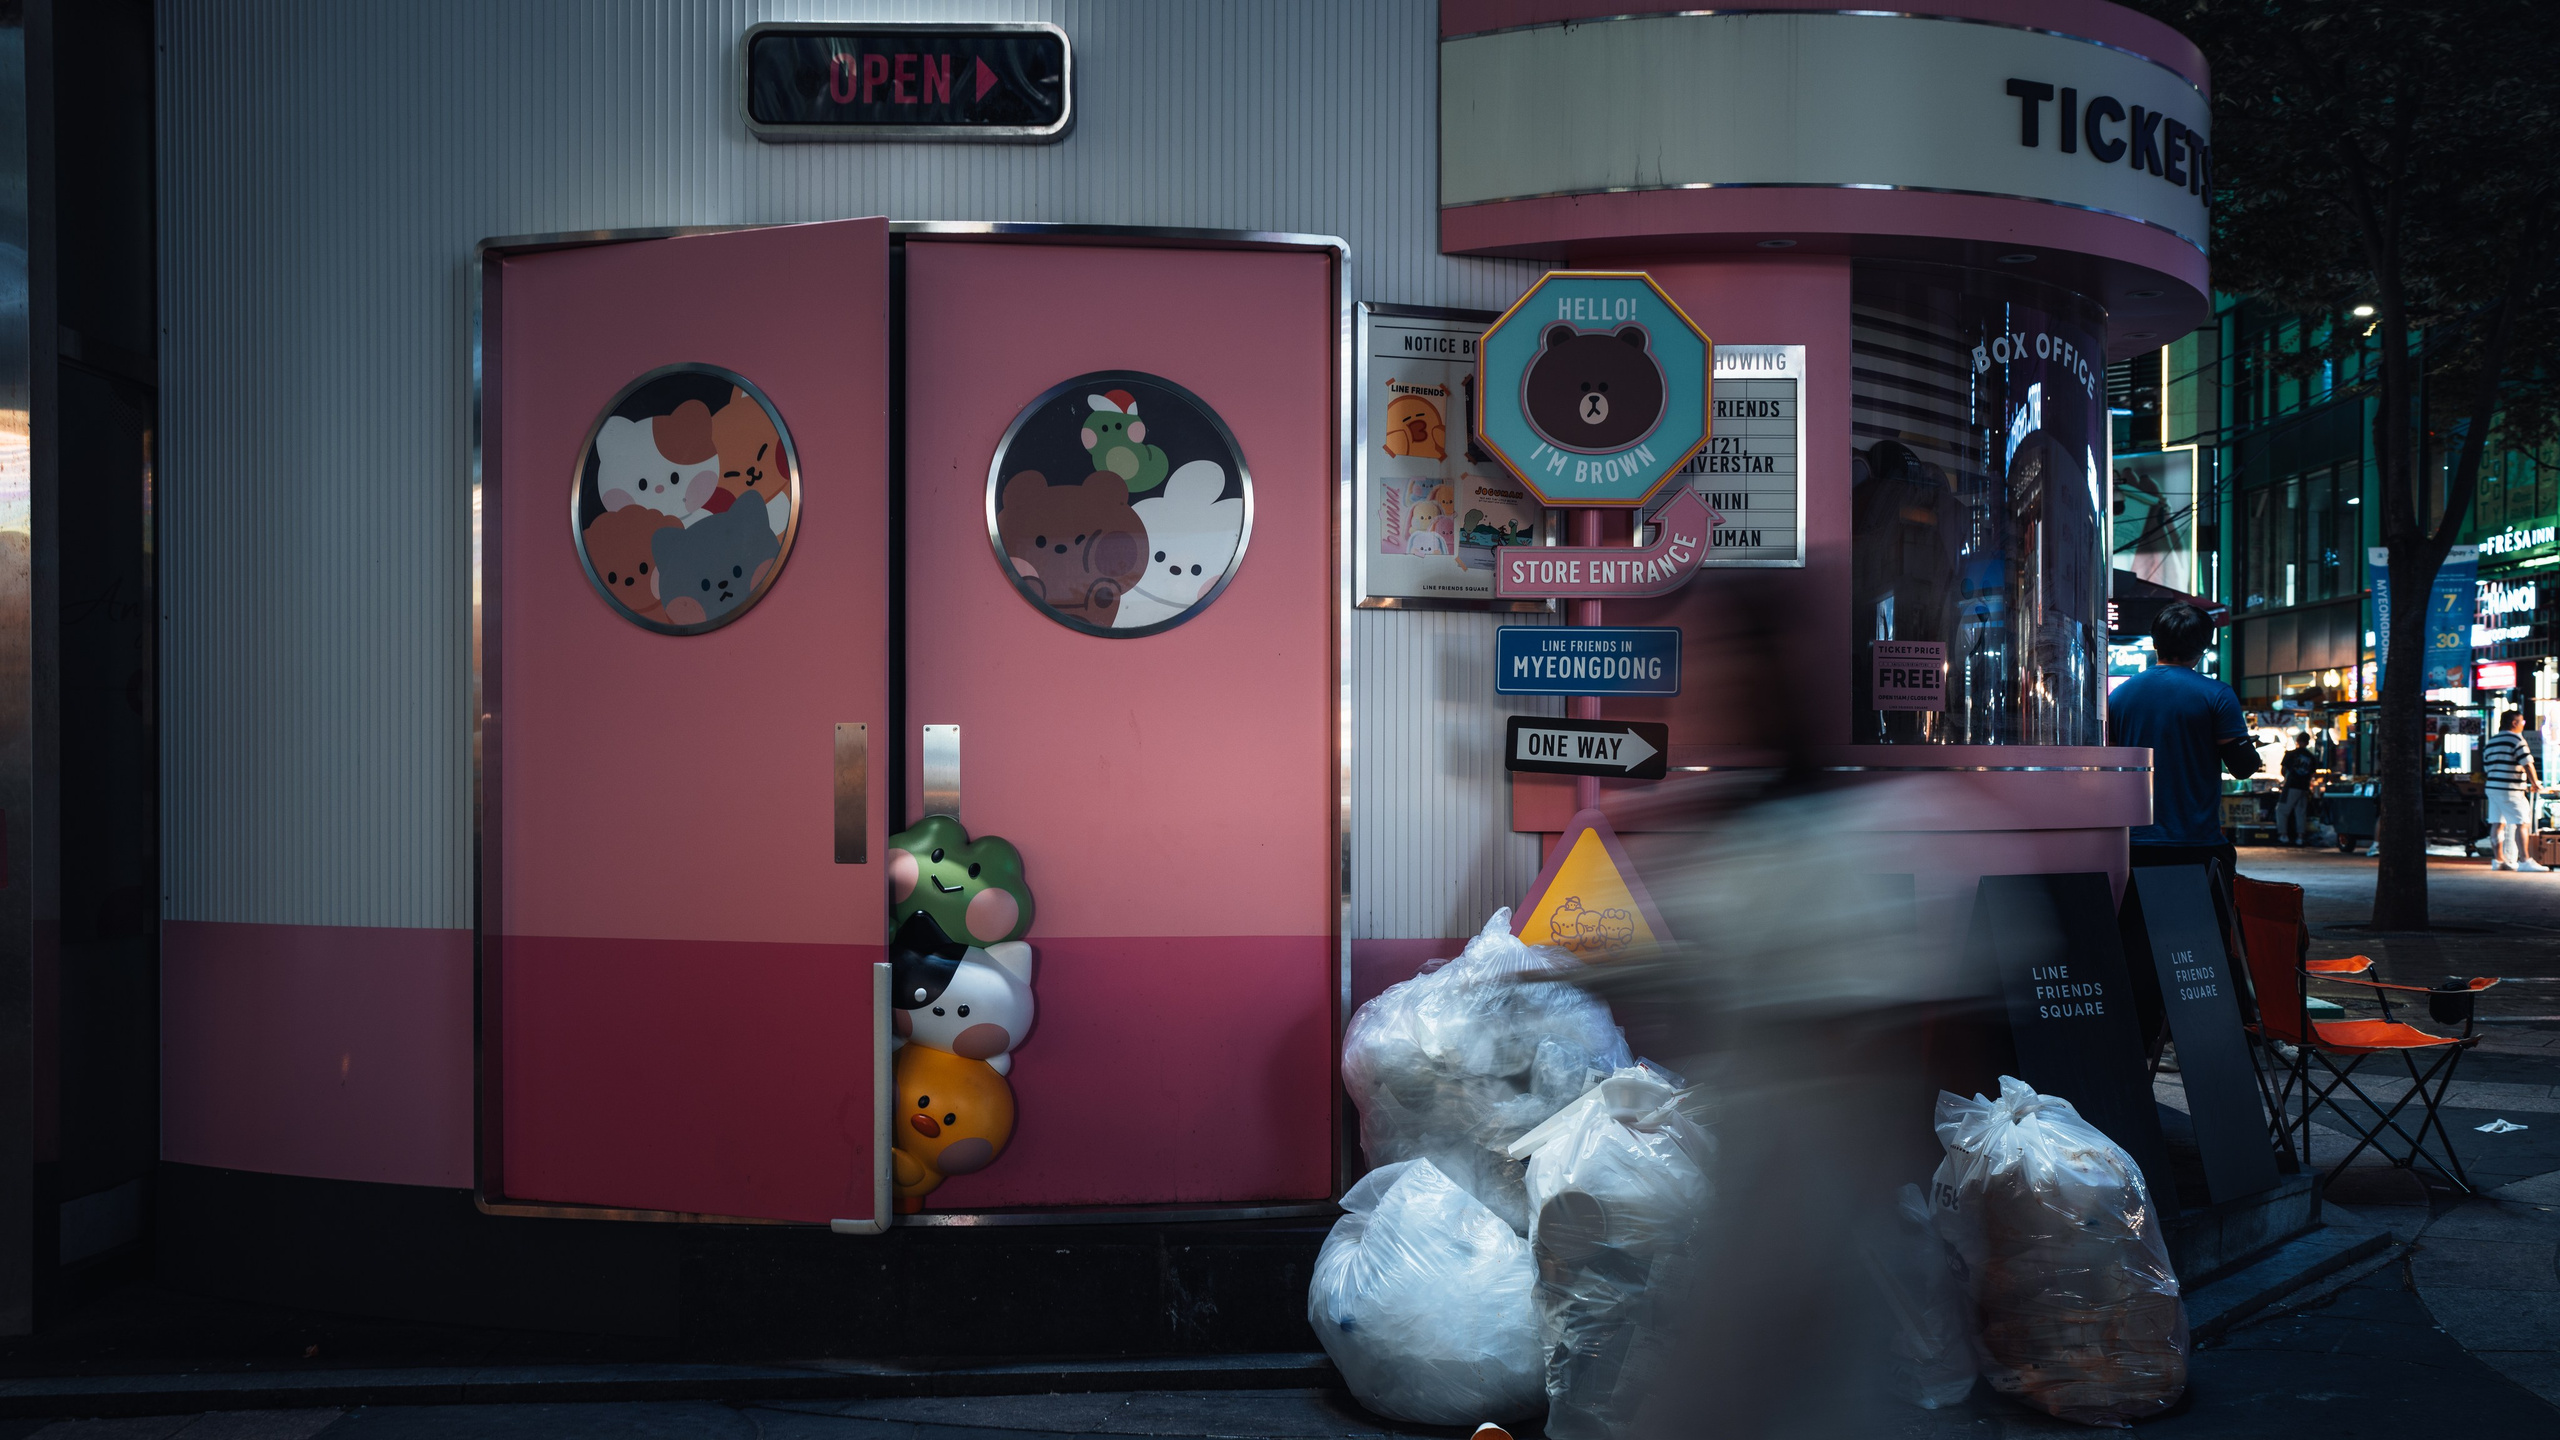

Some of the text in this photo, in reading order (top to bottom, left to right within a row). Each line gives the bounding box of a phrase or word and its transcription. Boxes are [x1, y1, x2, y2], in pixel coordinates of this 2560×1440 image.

[830, 53, 950, 104] OPEN
[1558, 297, 1637, 321] HELLO!
[1404, 335, 1456, 353] NOTICE
[1714, 352, 1787, 371] HOWING
[1971, 332, 2095, 400] BOX OFFICE
[1391, 384, 1445, 397] LINE FRIENDS
[1530, 442, 1657, 484] I'M BROWN
[1474, 485, 1524, 500] JOGUMAN
[1712, 530, 1761, 547] UMAN
[2532, 526, 2555, 545] INN
[1512, 532, 1698, 584] STORE ENTRANCE
[2443, 593, 2458, 613] 7
[1542, 639, 1633, 653] LINE FRIENDS IN
[1878, 646, 1940, 655] TICKET PRICE
[1513, 655, 1662, 680] MYEONGDONG
[1879, 669, 1940, 689] FREE!
[1528, 733, 1623, 760] ONE WAY
[2172, 950, 2194, 965] LINE
[2032, 965, 2070, 981] LINE
[2175, 966, 2215, 982] FRIENDS
[2036, 982, 2104, 1000] FRIENDS
[2180, 984, 2218, 1001] SQUARE
[2040, 1001, 2105, 1019] SQUARE
